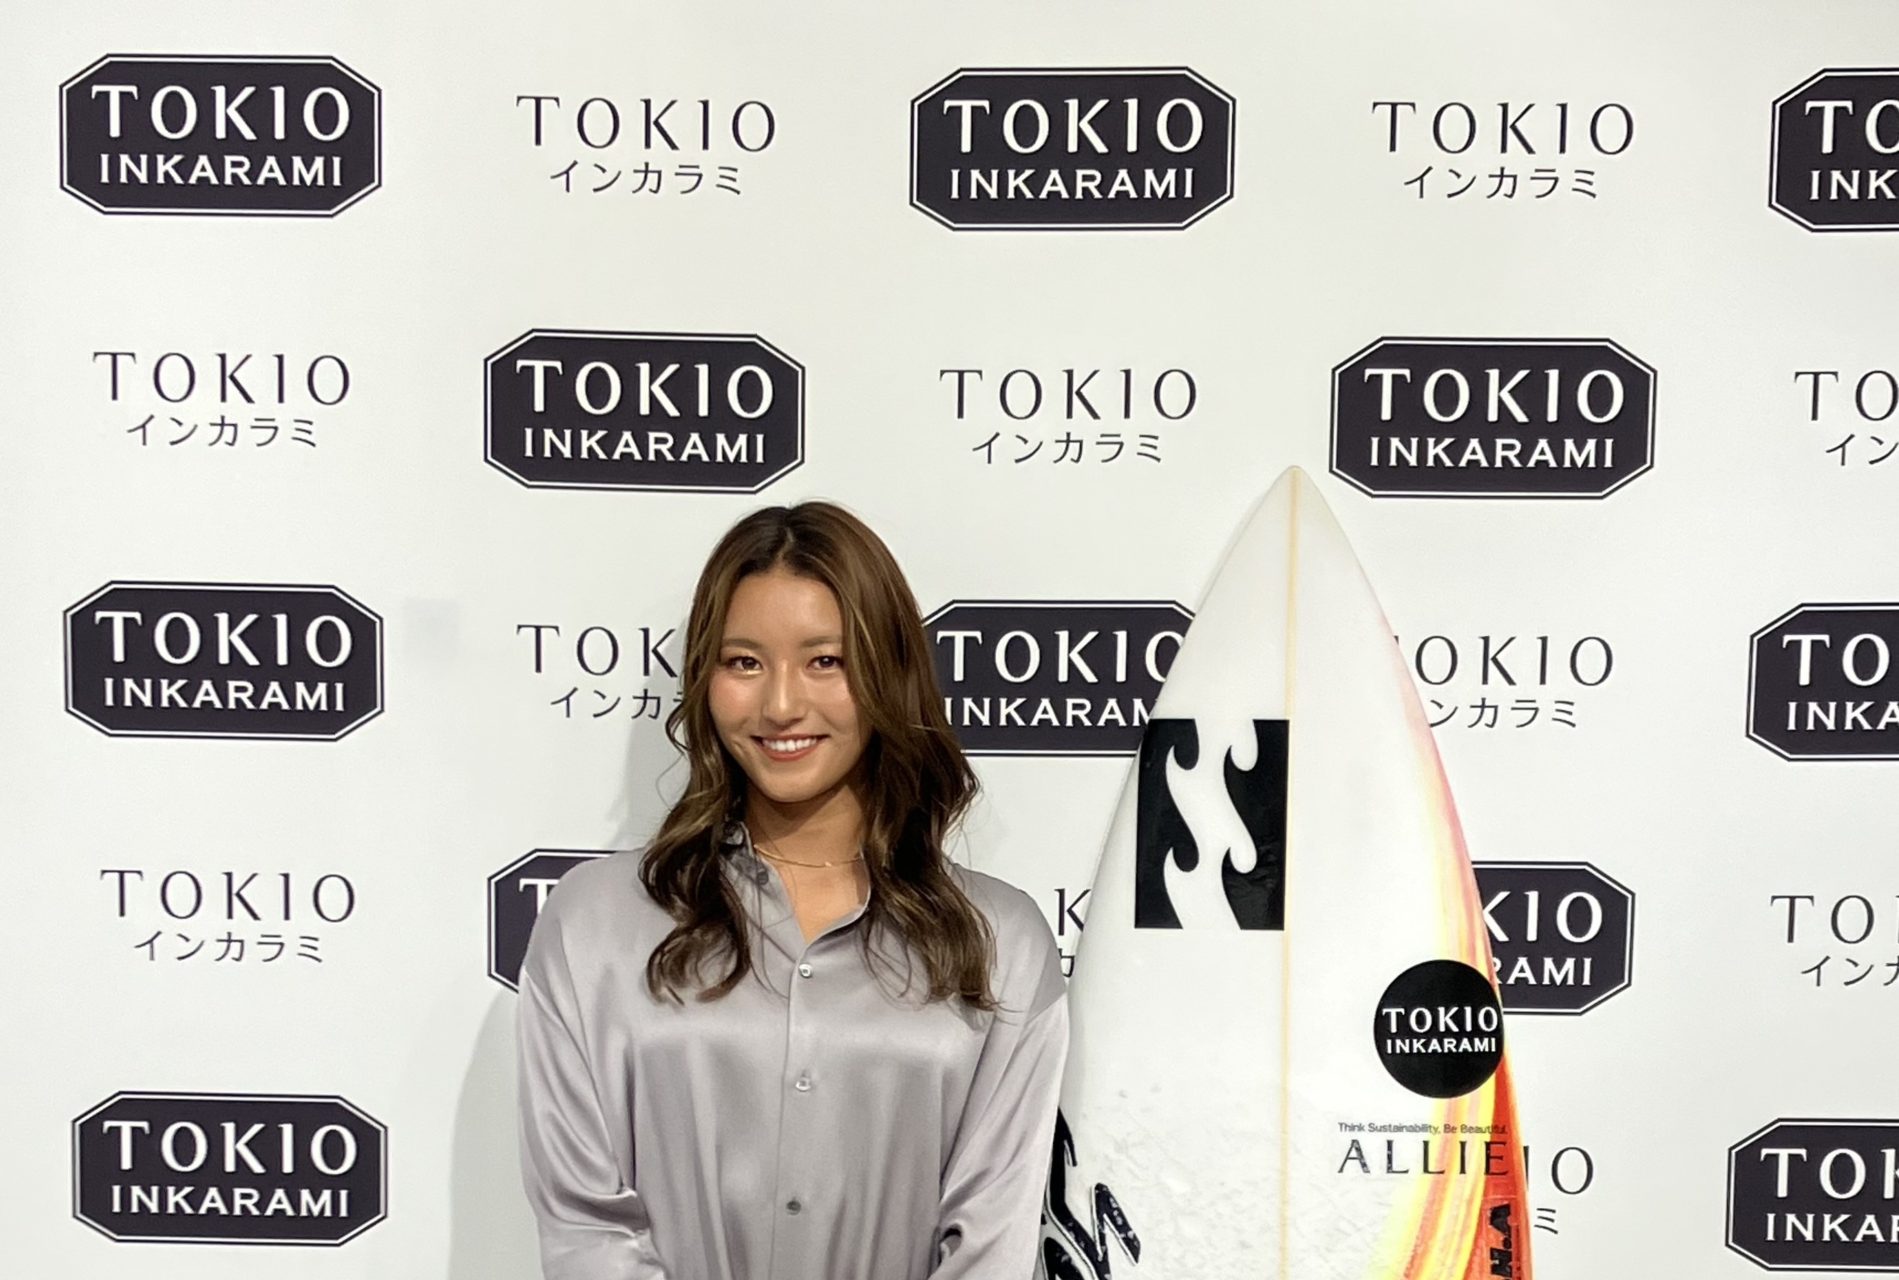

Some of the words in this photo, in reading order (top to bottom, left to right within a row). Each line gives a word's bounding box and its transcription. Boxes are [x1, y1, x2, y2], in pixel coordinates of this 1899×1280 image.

[91, 84, 350, 141] TOKIO
[516, 95, 775, 153] TOKIO
[943, 97, 1203, 154] TOKIO
[1372, 101, 1634, 156] TOKIO
[100, 153, 342, 187] INKARAMI
[550, 159, 741, 196] インカラミ
[950, 168, 1193, 199] INKARAMI
[1403, 165, 1597, 199] インカラミ
[93, 351, 350, 406] TOKIO
[516, 359, 773, 419] TOKIO
[939, 368, 1197, 420] TOKIO
[1364, 368, 1624, 423] TOKIO
[126, 414, 317, 448] インカラミ
[524, 427, 764, 463] INKARAMI
[972, 431, 1162, 465] インカラミ
[1370, 436, 1614, 468] INKARAMI
[94, 610, 352, 668] TOKIO
[1393, 635, 1613, 686] OKIO
[104, 677, 344, 712] INKARAMI
[100, 869, 355, 923] TOKIO
[1770, 894, 1899, 944] TO
[134, 930, 323, 963] インカラミ
[1382, 1006, 1498, 1033] TOKIO
[1387, 1037, 1496, 1054] INKARAMI
[1338, 1122, 1365, 1133] Think
[1443, 1124, 1457, 1134] Be
[102, 1120, 357, 1175] TOKIO
[1337, 1139, 1509, 1176] ALLIE
[112, 1184, 348, 1217] INKARAMI
[1765, 1212, 1899, 1243] INKA
